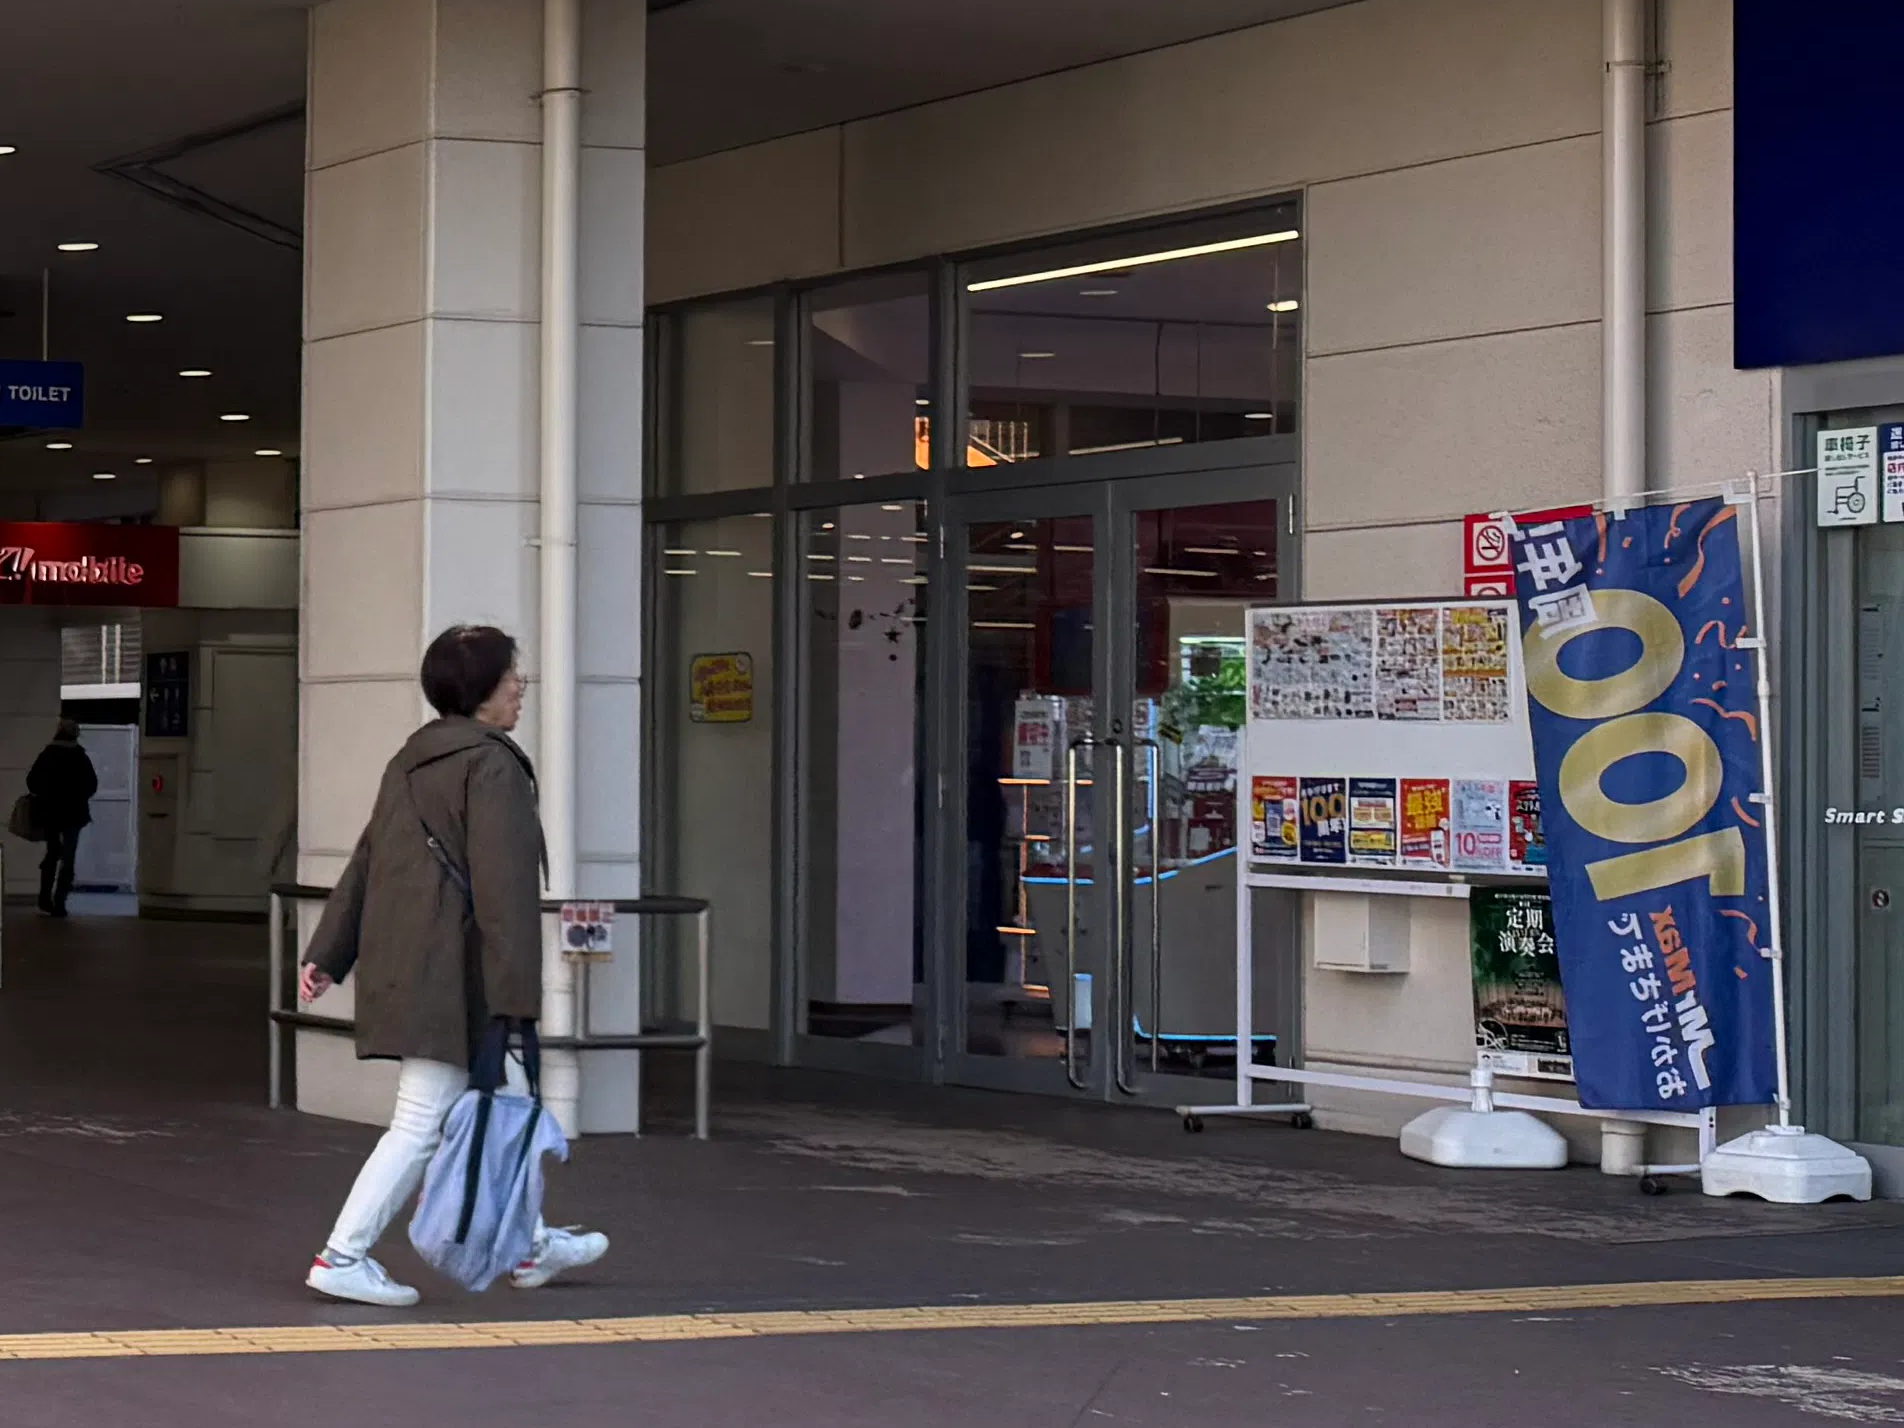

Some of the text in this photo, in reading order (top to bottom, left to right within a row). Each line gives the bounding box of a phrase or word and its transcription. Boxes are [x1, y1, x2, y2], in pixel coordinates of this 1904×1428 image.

[7, 384, 72, 402] TOILET
[1824, 434, 1870, 452] 車椅子
[1824, 807, 1886, 824] Smart
[1455, 832, 1476, 856] 10
[1506, 907, 1544, 930] 定期
[1498, 930, 1555, 958] 演奏会
